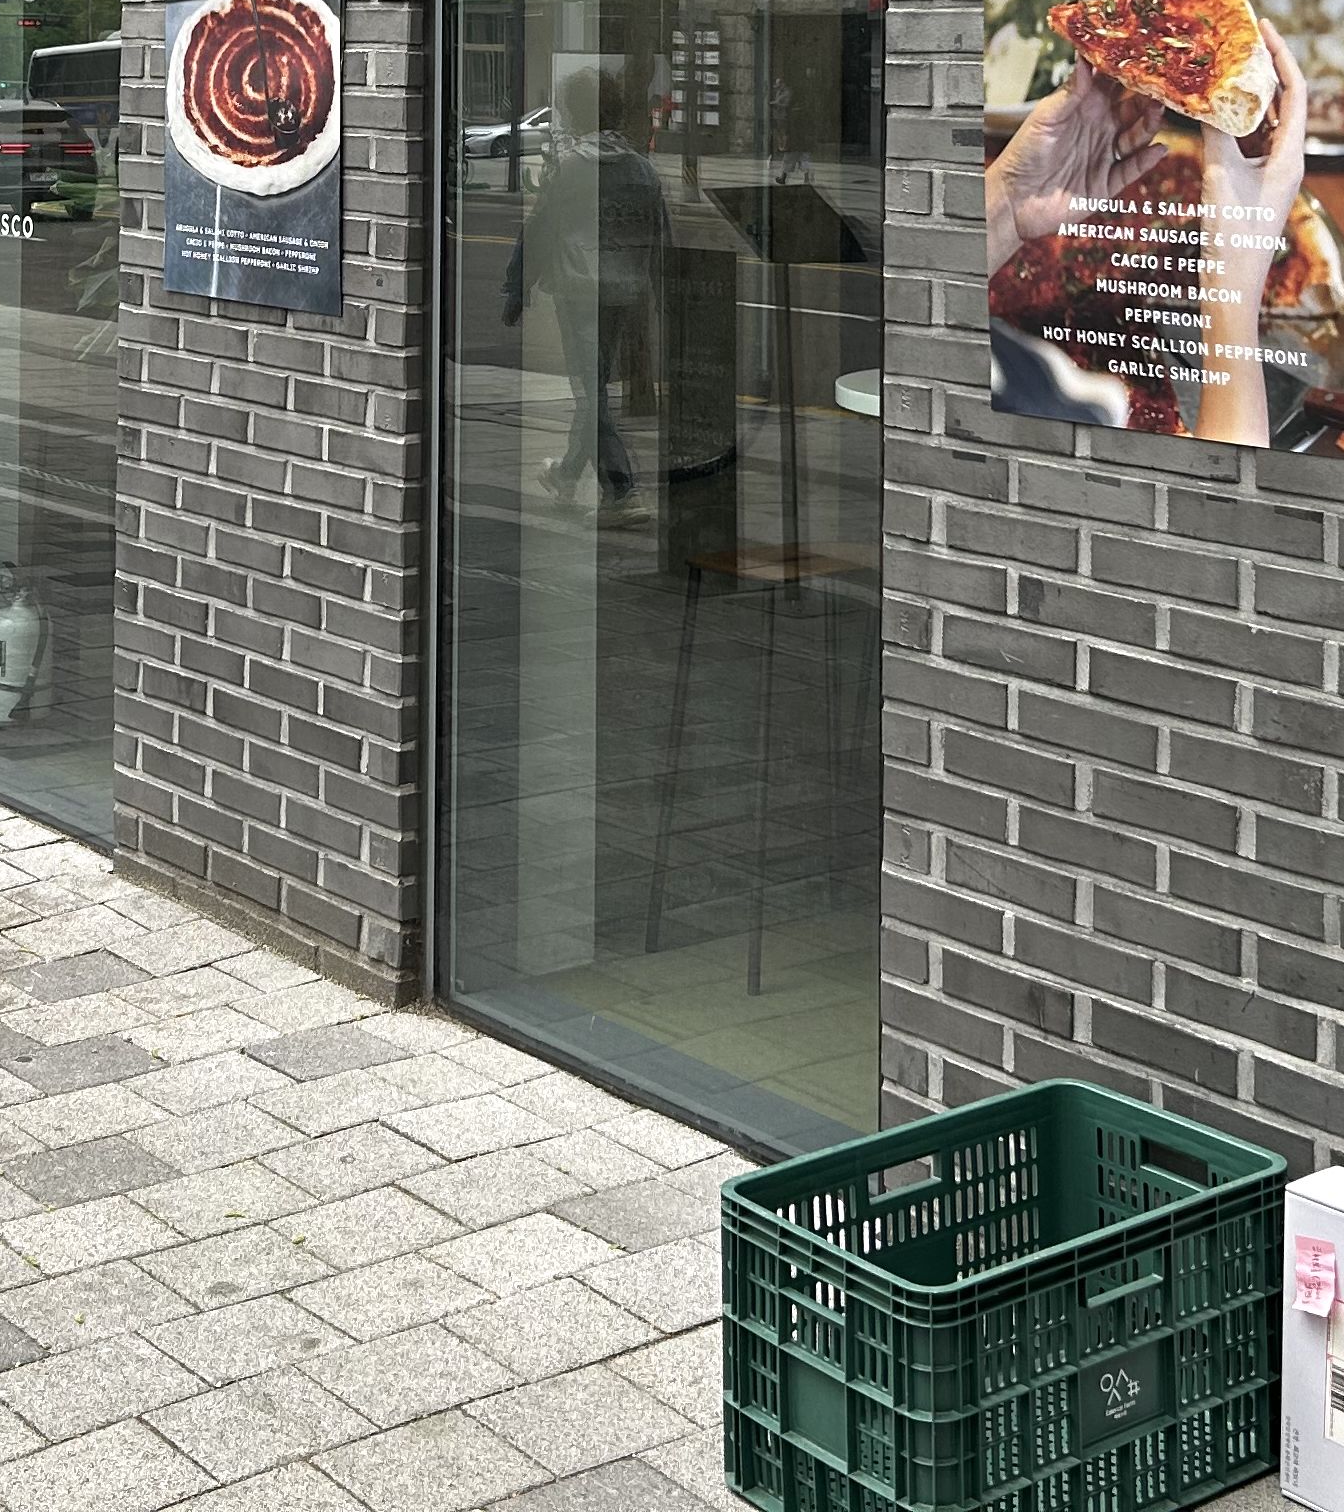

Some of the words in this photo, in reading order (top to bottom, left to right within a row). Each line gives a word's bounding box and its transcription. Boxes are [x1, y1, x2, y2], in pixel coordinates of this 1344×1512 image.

[1069, 197, 1137, 215] ARUGULA
[1142, 200, 1153, 215] &
[1157, 201, 1217, 218] SALAMI
[1221, 205, 1275, 222] COTTO
[1057, 222, 1134, 241] AMERICAN
[1139, 228, 1209, 246] SAUSAGE
[1214, 233, 1224, 247] &
[1230, 234, 1287, 251] ONION
[1111, 253, 1157, 270] CACIO
[1163, 257, 1172, 271] E
[1178, 257, 1226, 275] PEPPE
[1096, 278, 1182, 299] MUSHROOM
[1188, 287, 1241, 304] BACON
[1125, 307, 1212, 329] PEPPERONI
[1042, 325, 1072, 342] HOT
[1077, 330, 1126, 348] HONEY
[1131, 335, 1209, 356] SCALLION
[1214, 343, 1308, 367] PEPPERONI
[1108, 359, 1165, 380] GARLIC
[1169, 366, 1231, 386] SHRIMP
